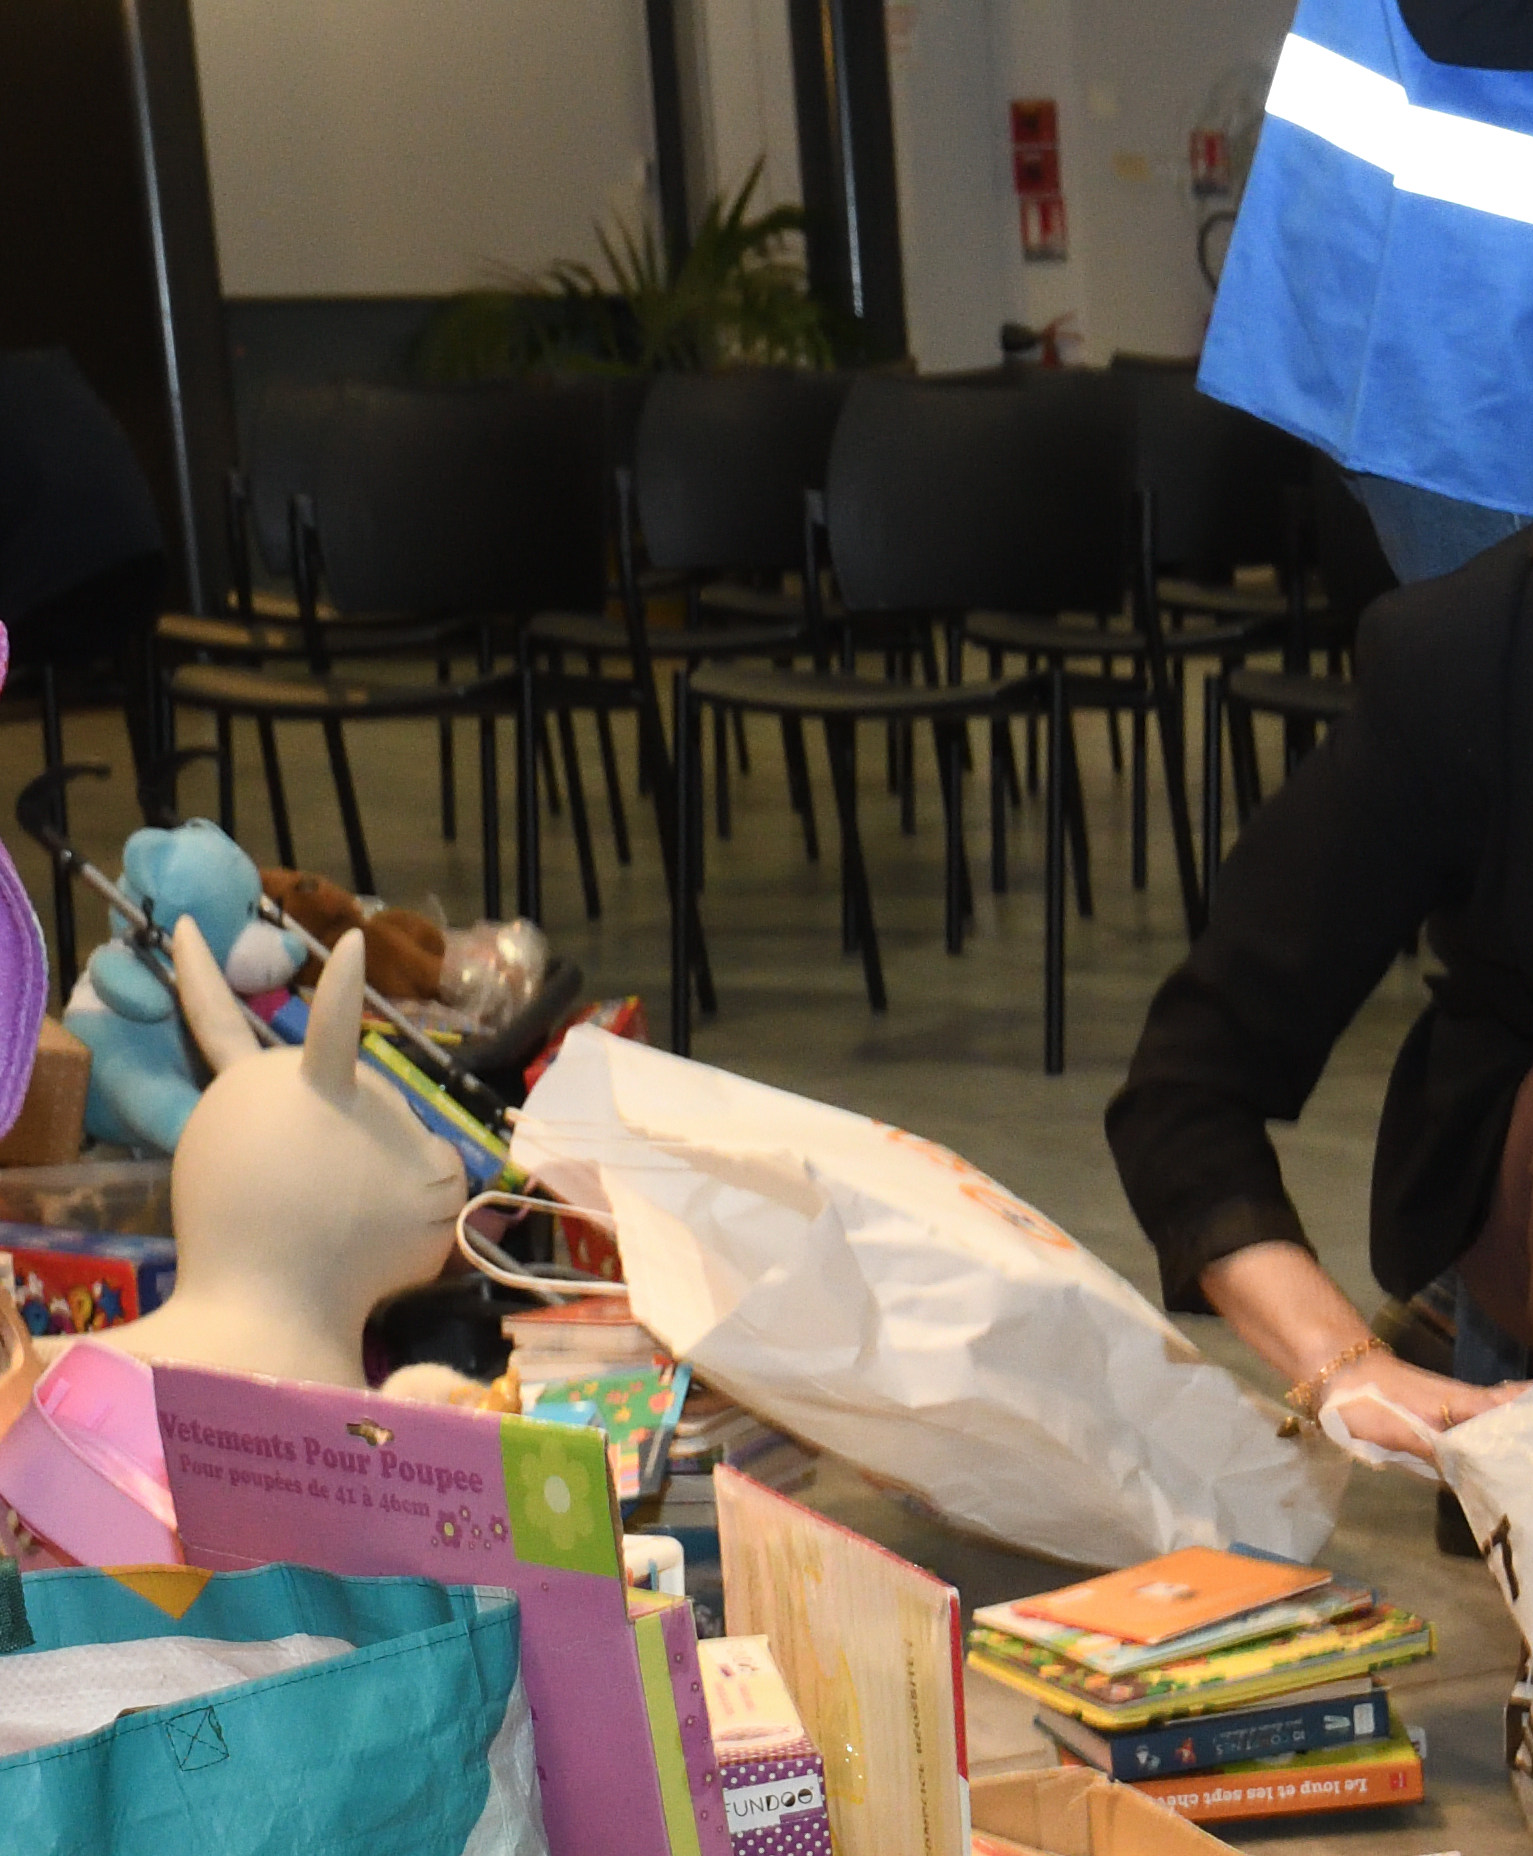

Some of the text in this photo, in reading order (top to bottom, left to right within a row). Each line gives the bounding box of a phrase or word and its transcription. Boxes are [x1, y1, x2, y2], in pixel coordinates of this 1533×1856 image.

[158, 1411, 483, 1494] Vetements Pour Poupee
[178, 1454, 223, 1480] Pour
[308, 1477, 330, 1499] de
[1247, 1785, 1274, 1801] les
[1277, 1784, 1296, 1798] et
[1300, 1779, 1340, 1795] loup
[1345, 1777, 1368, 1793] Le
[1203, 1788, 1242, 1804] sept
